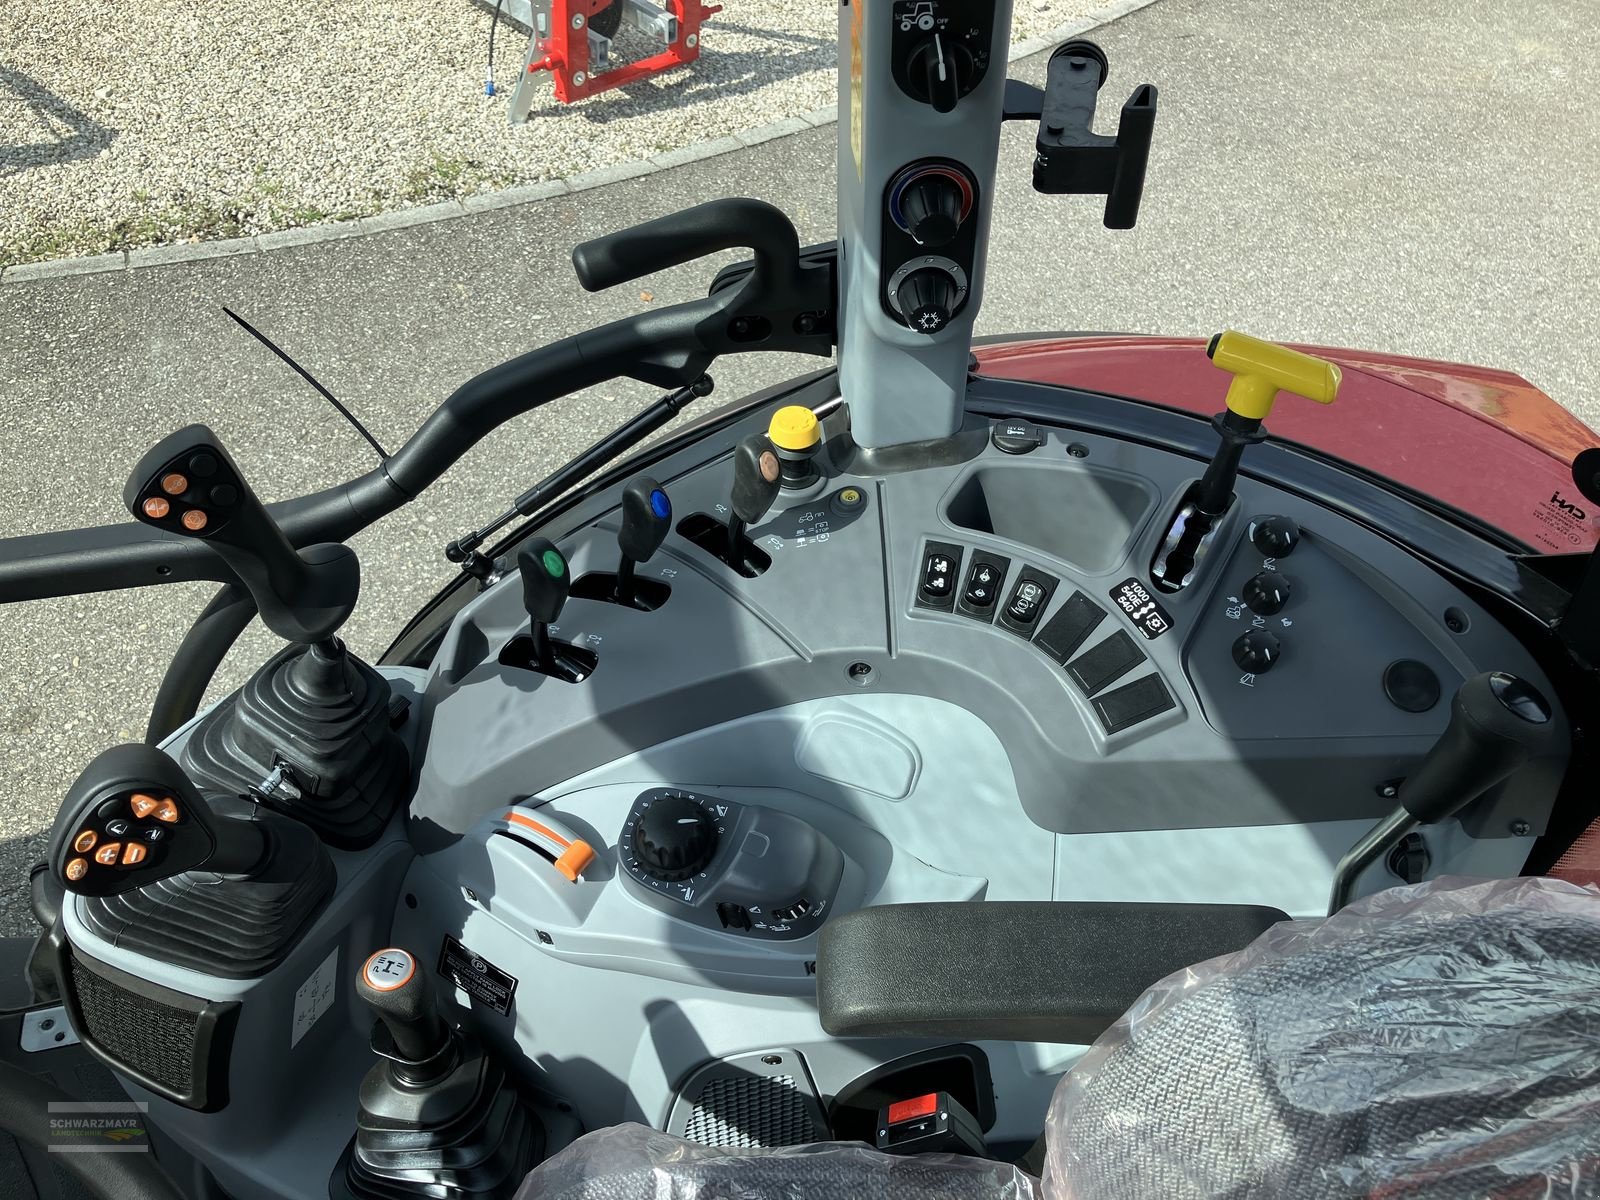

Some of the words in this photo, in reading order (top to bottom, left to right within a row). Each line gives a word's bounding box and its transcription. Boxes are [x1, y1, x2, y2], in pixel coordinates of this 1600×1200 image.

[1121, 586, 1142, 607] 540E
[1130, 582, 1150, 601] 1000
[1118, 596, 1134, 612] 540
